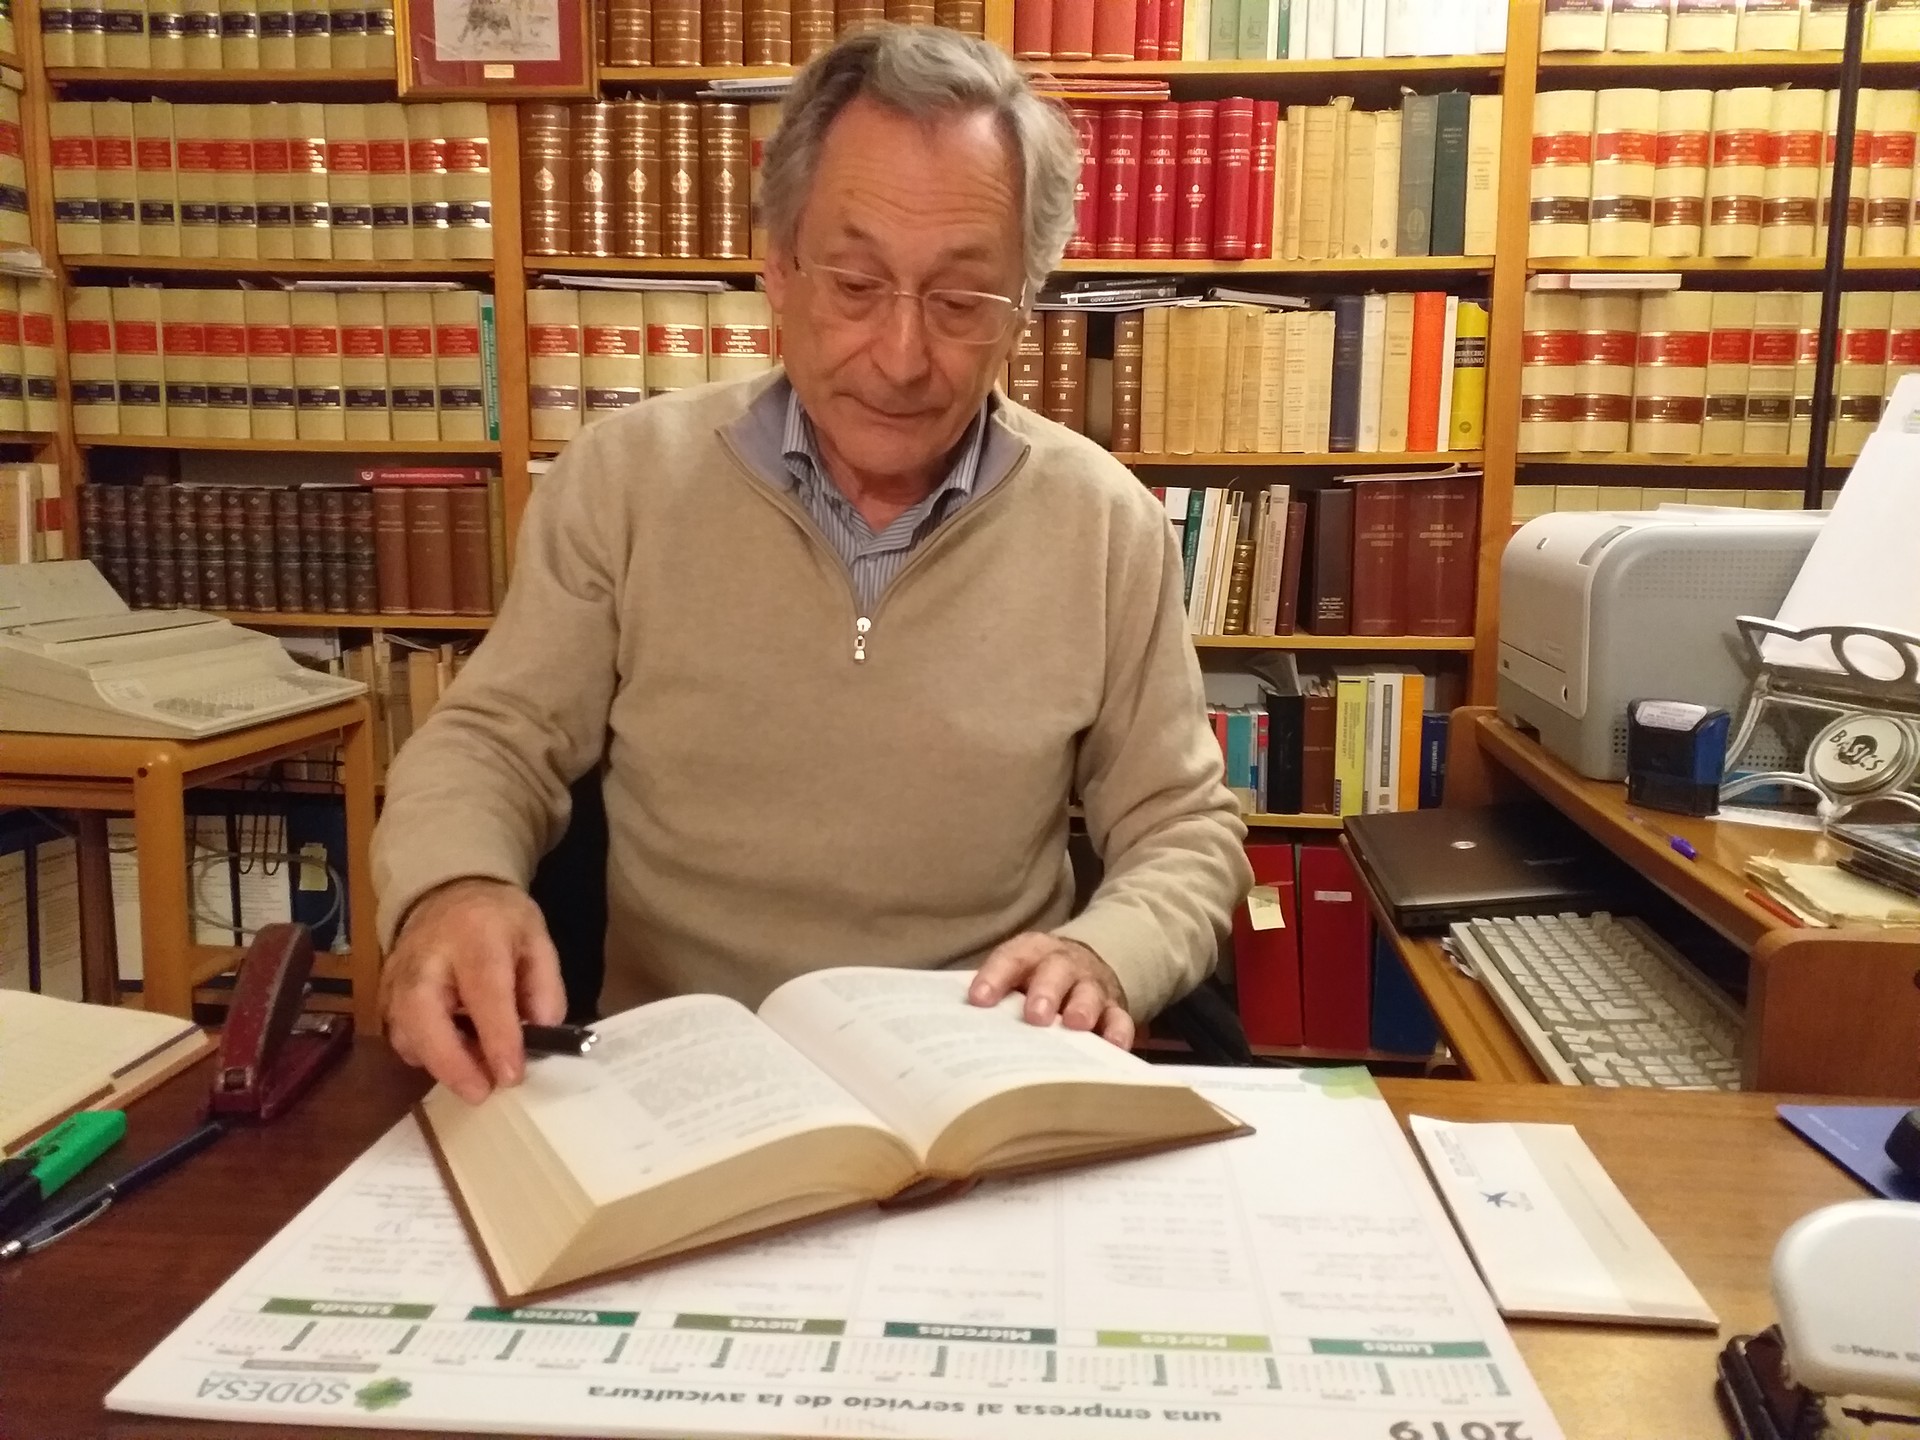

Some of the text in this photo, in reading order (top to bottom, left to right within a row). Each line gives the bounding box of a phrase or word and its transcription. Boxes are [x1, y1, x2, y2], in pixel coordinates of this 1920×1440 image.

[1829, 729, 1885, 771] BASICS
[511, 1307, 600, 1324] Viernes
[918, 1324, 1032, 1342] Miércoles
[1140, 1334, 1228, 1349] Martes
[1362, 1341, 1435, 1355] Lunes
[1851, 1344, 1899, 1360] Petrus
[196, 1375, 352, 1405] SODESA
[587, 1385, 1222, 1423] una empresa al servicio de la avicultura
[1389, 1420, 1534, 1440] 2019
